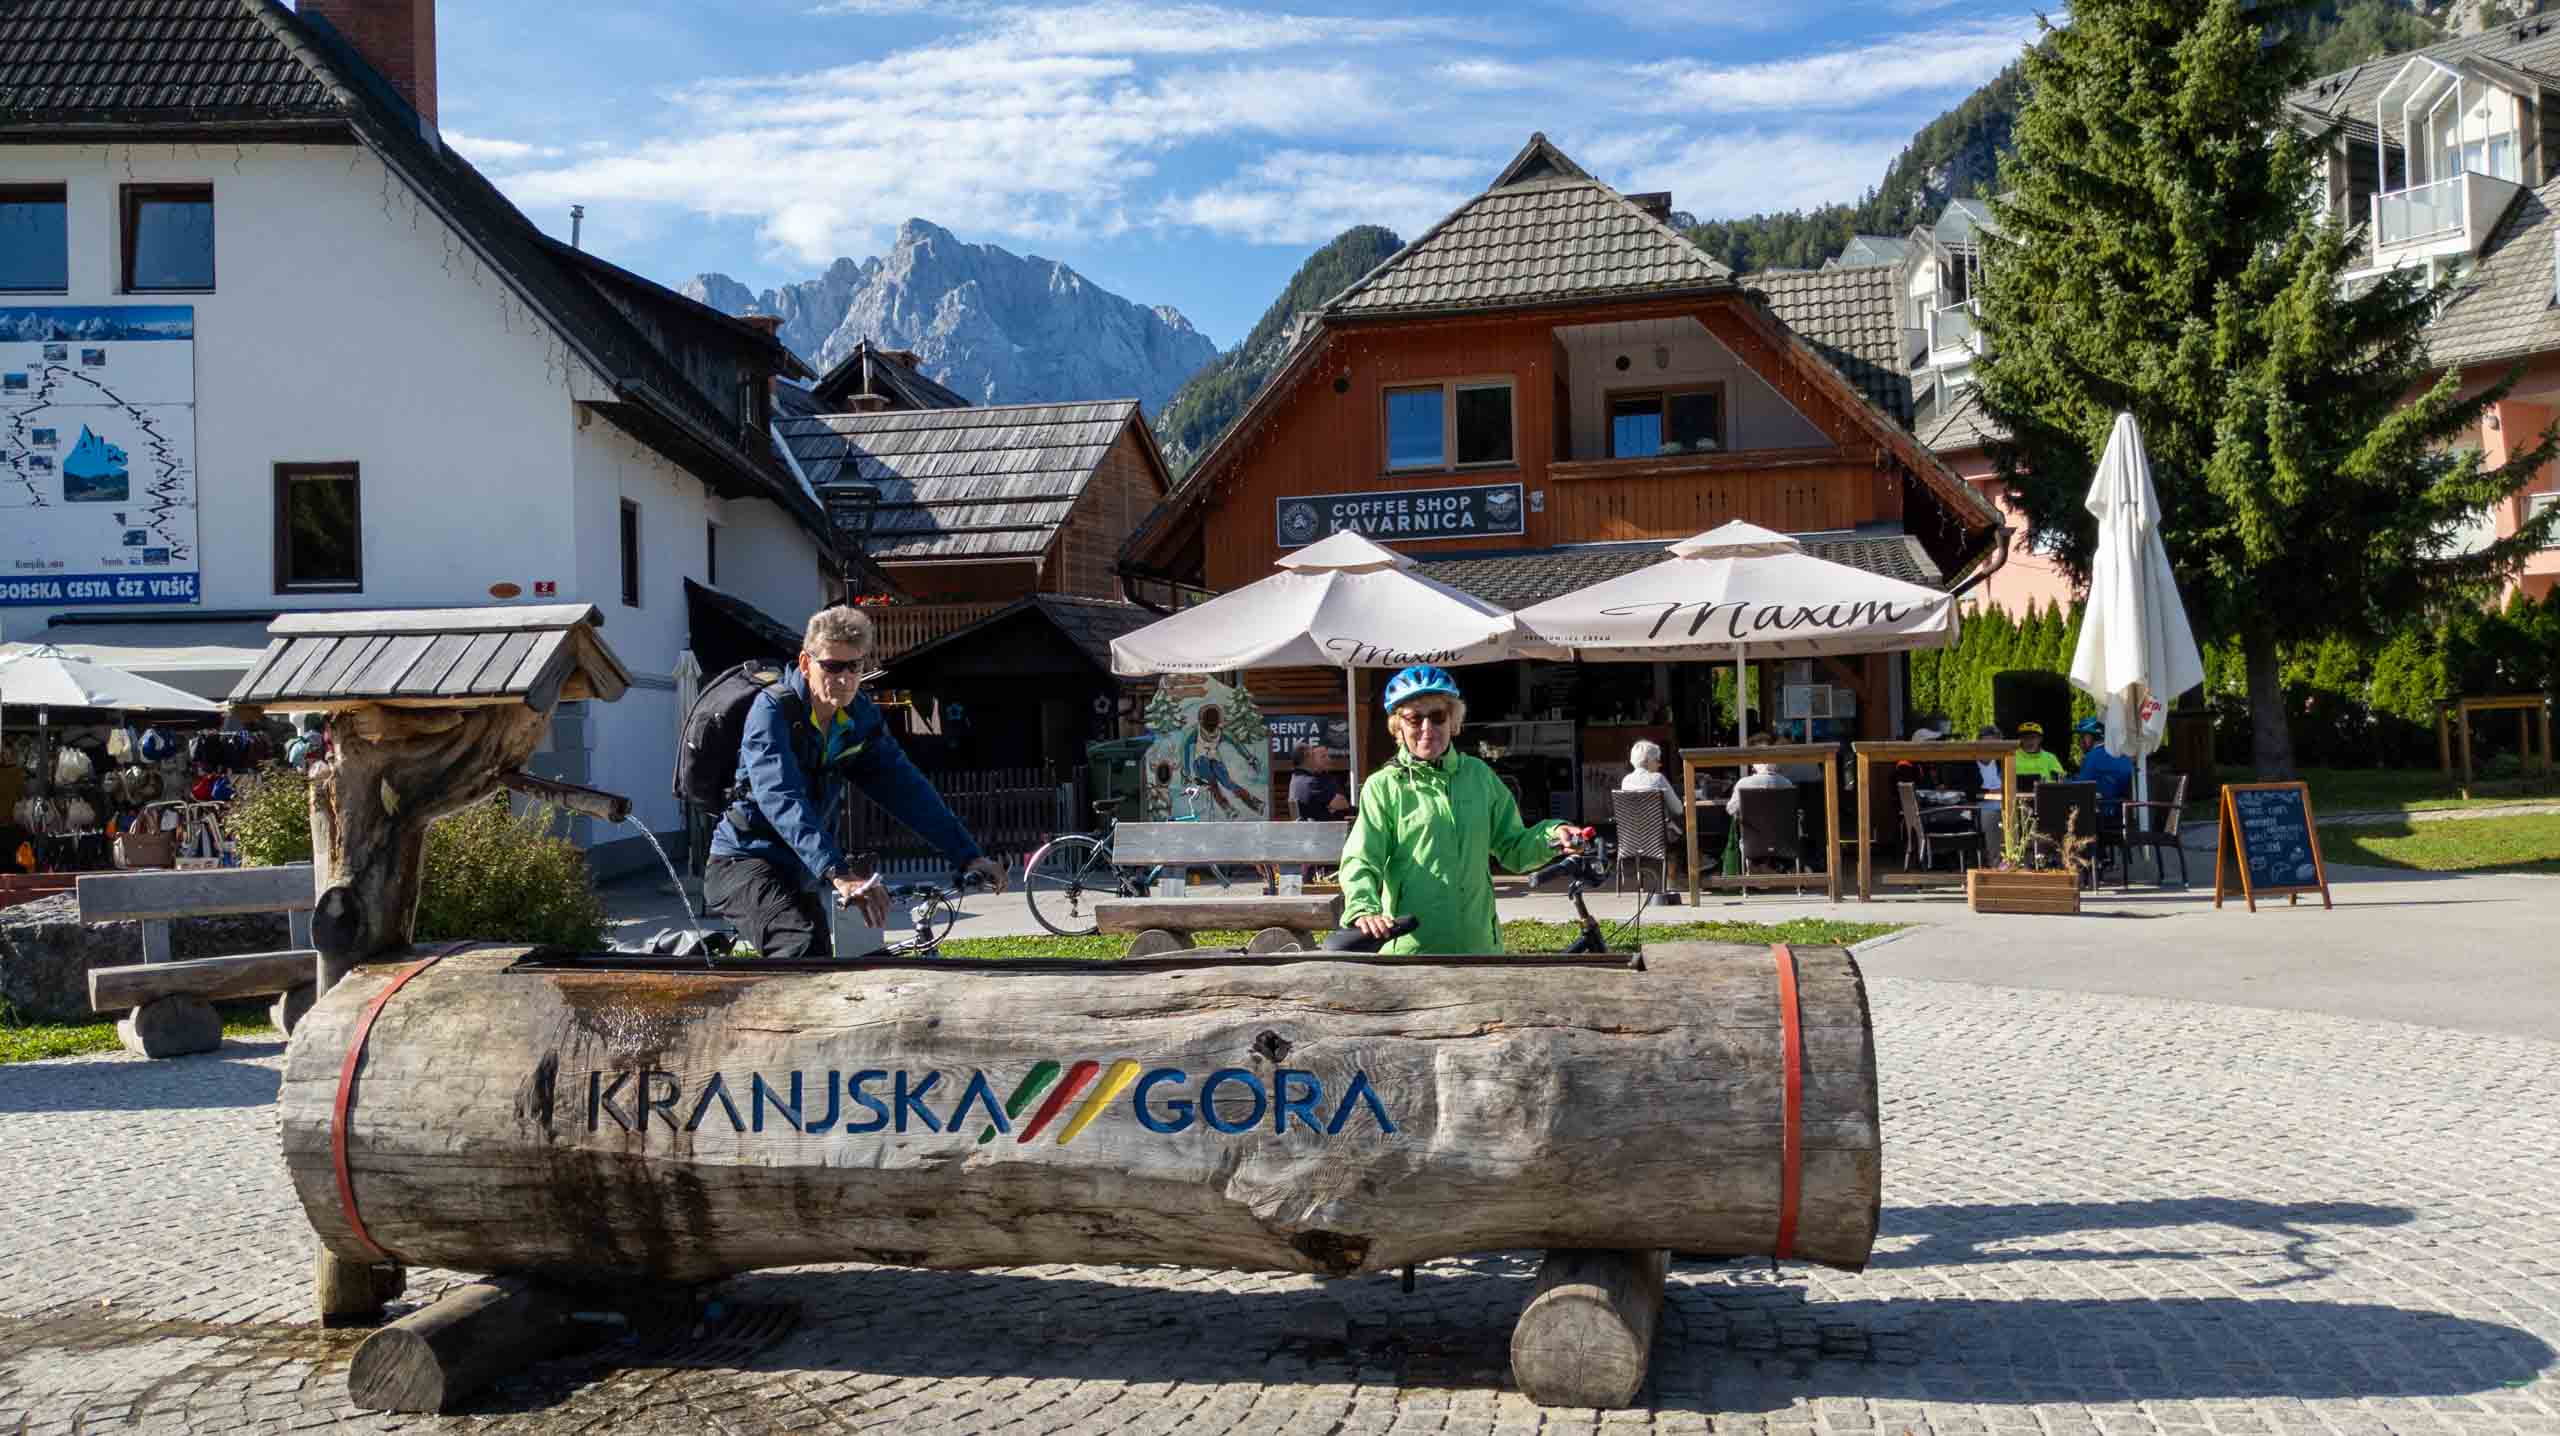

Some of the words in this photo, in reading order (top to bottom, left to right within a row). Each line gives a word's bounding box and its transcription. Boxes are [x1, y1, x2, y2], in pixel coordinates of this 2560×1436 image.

[1332, 499, 1408, 517] COFFEE
[1415, 496, 1471, 512] SHOP
[1330, 512, 1476, 534] KAVARNICA
[67, 580, 111, 598] CESTA
[116, 577, 144, 597] ČEZ
[150, 576, 194, 596] VRŠIČ
[1600, 600, 1911, 640] Maxim
[1326, 638, 1463, 666] Maxim
[1270, 722, 1306, 734] RENT
[1309, 722, 1319, 734] A
[588, 1070, 1009, 1133] KRANJSKA
[1133, 1068, 1397, 1135] GORA
